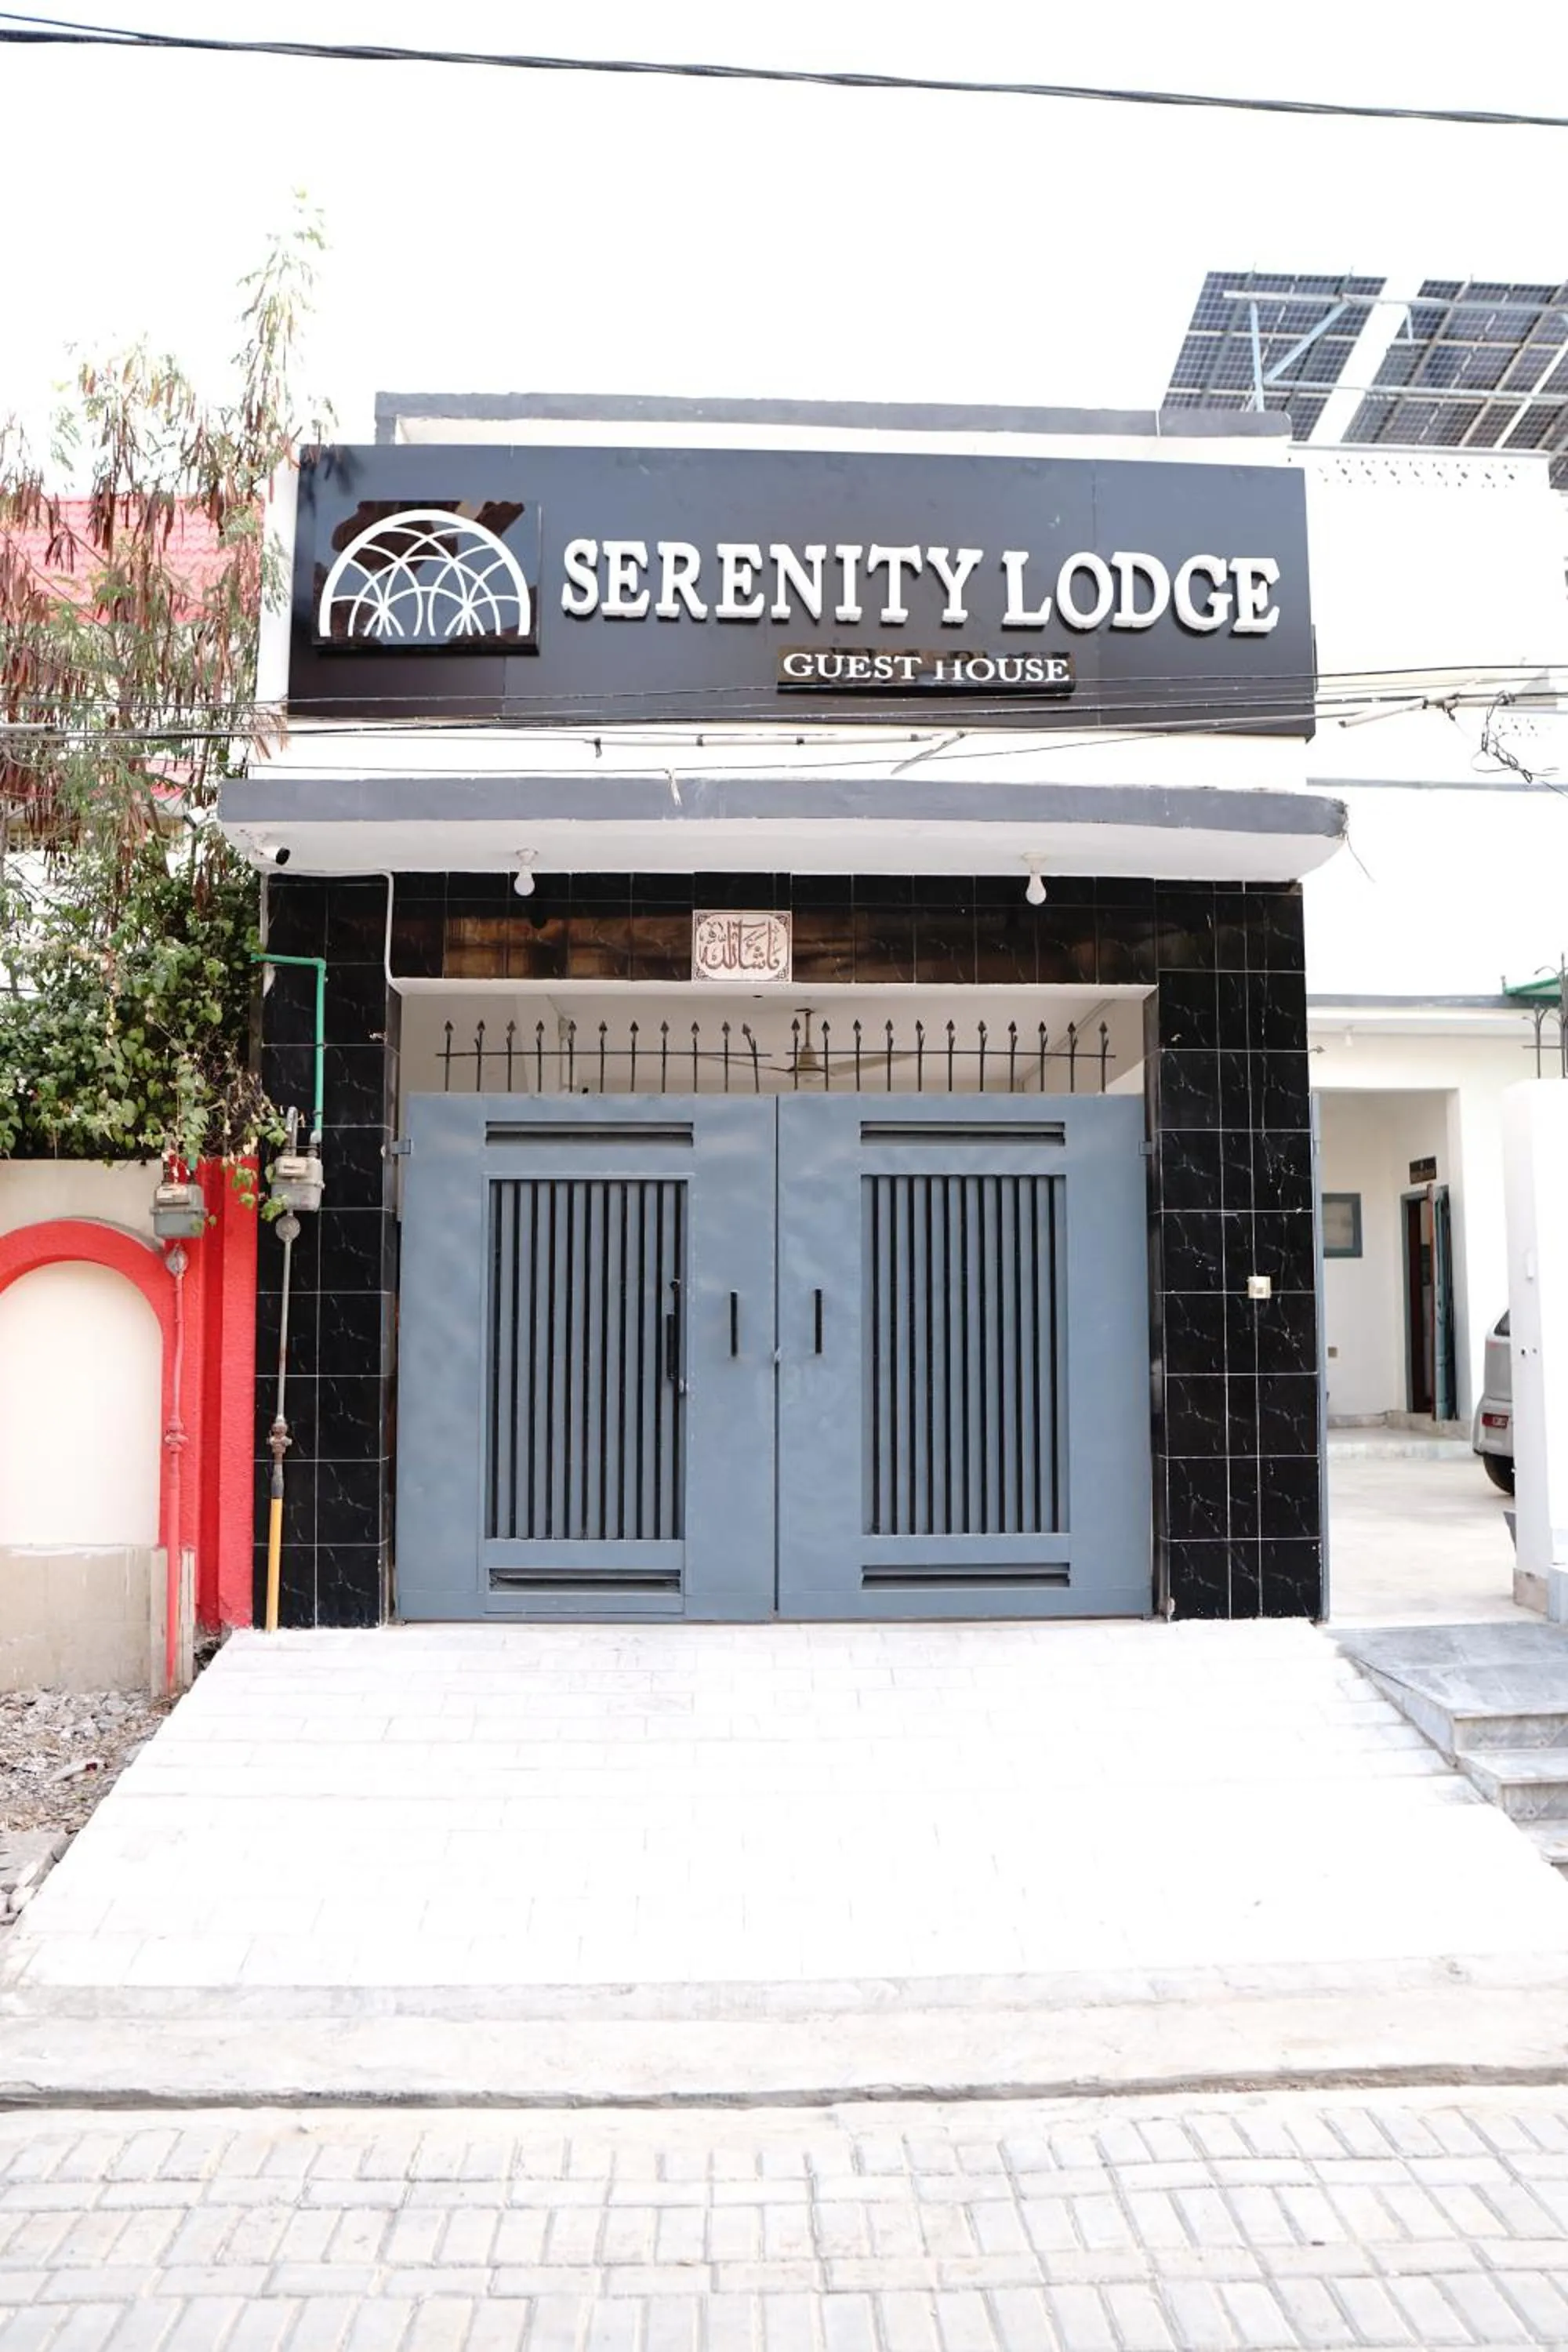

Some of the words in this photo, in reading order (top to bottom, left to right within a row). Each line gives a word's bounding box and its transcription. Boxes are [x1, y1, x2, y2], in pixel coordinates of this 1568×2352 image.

[561, 539, 984, 624] SERENITY
[1001, 550, 1280, 633] LODGE
[783, 652, 923, 680] GUEST
[935, 657, 1070, 682] HOUSE
